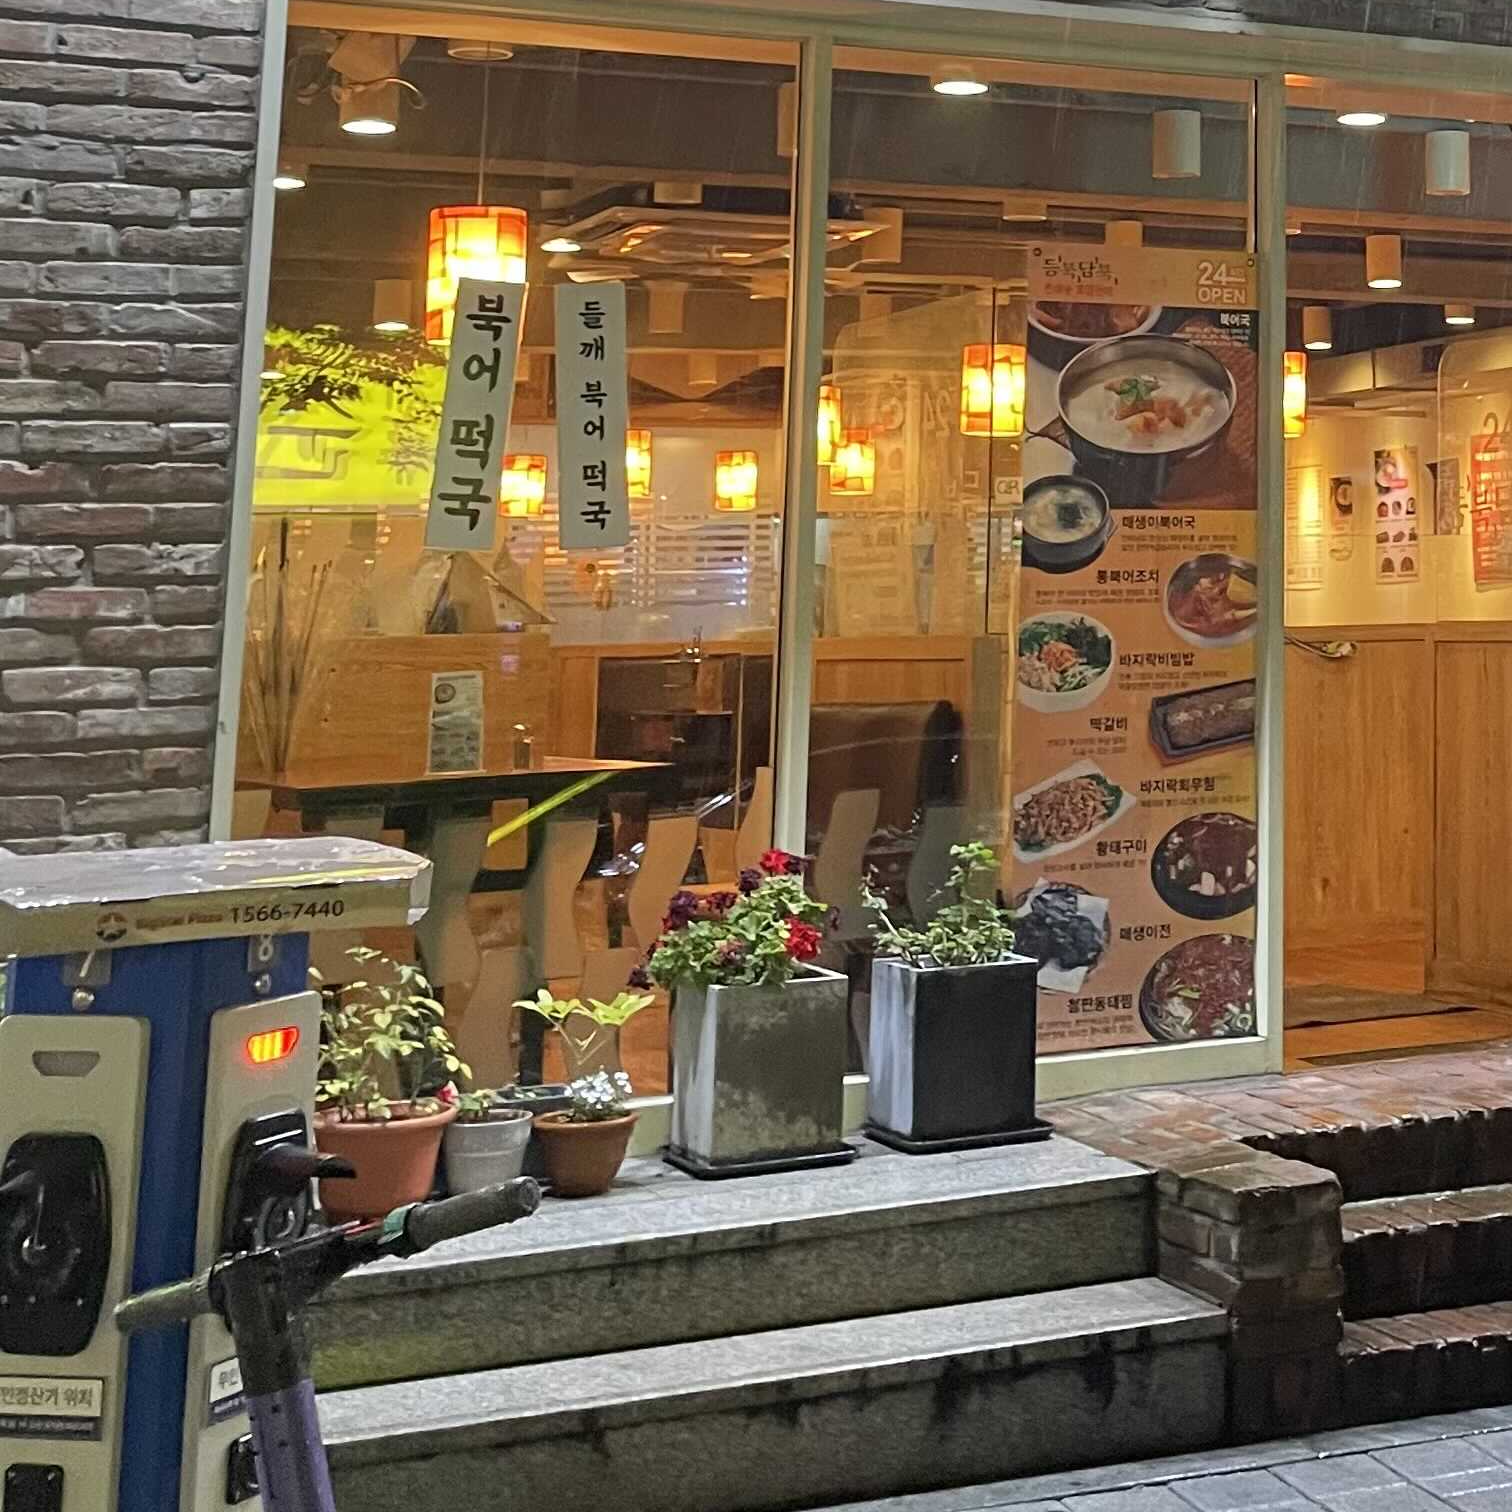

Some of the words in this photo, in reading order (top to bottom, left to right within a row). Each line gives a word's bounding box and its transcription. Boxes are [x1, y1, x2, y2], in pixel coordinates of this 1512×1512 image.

[1199, 261, 1229, 286] 24
[1199, 288, 1247, 304] OPEN
[577, 300, 607, 363] 들깨
[1220, 313, 1251, 327] 북어국
[462, 293, 513, 393] 북어
[579, 378, 609, 441] 북어
[438, 412, 497, 533] 떡국
[579, 458, 612, 531] 떡국
[1119, 652, 1195, 668] 바지락비빔밥
[230, 899, 345, 925] 1566-7440
[1119, 924, 1171, 942] 매생이전
